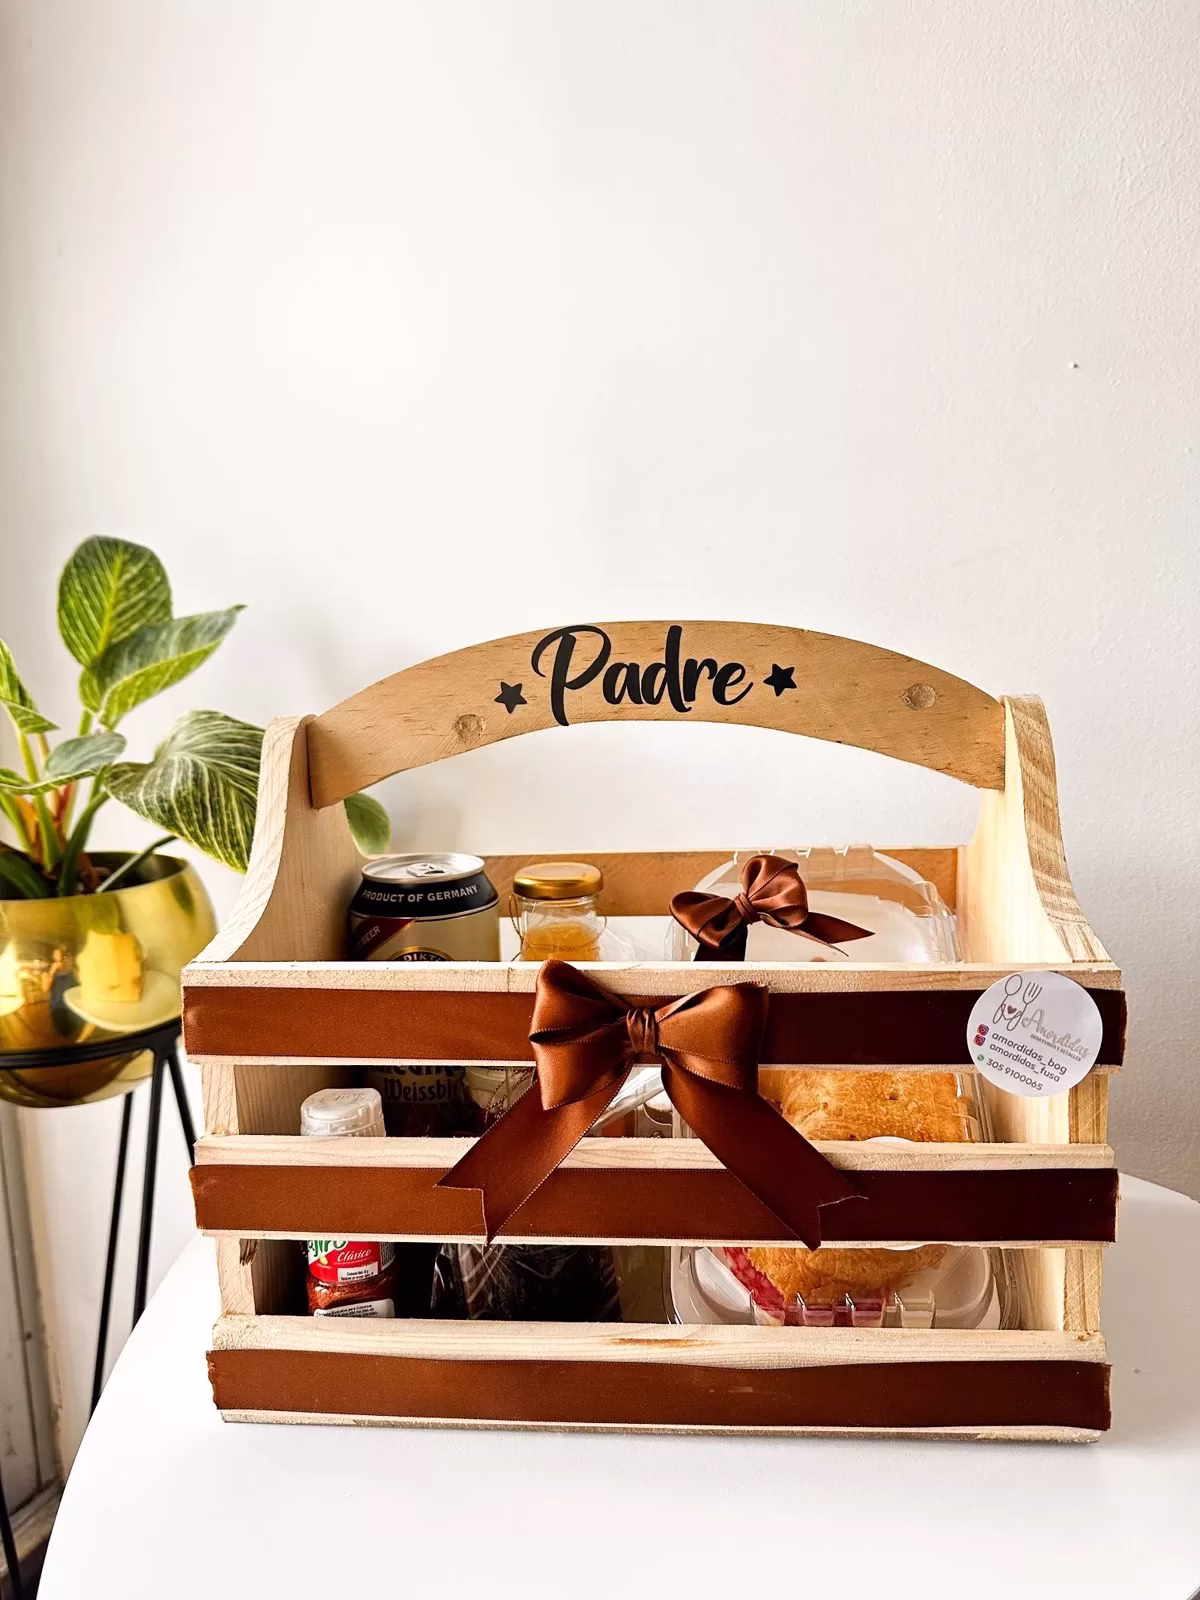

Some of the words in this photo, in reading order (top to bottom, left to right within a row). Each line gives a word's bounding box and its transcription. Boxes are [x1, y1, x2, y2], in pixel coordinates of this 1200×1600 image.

[531, 624, 754, 727] Padre
[362, 889, 405, 903] PRODUCT
[407, 893, 424, 903] OF
[427, 884, 478, 902] GERMANY
[361, 925, 381, 945] BEER
[1021, 1008, 1089, 1059] Amordidas
[989, 1043, 1061, 1082] amordidas_fusa
[992, 1033, 1067, 1075] amordidas_bog
[986, 1058, 1005, 1071] 305
[1004, 1067, 1043, 1091] 9100065
[337, 1249, 371, 1262] Clásico
